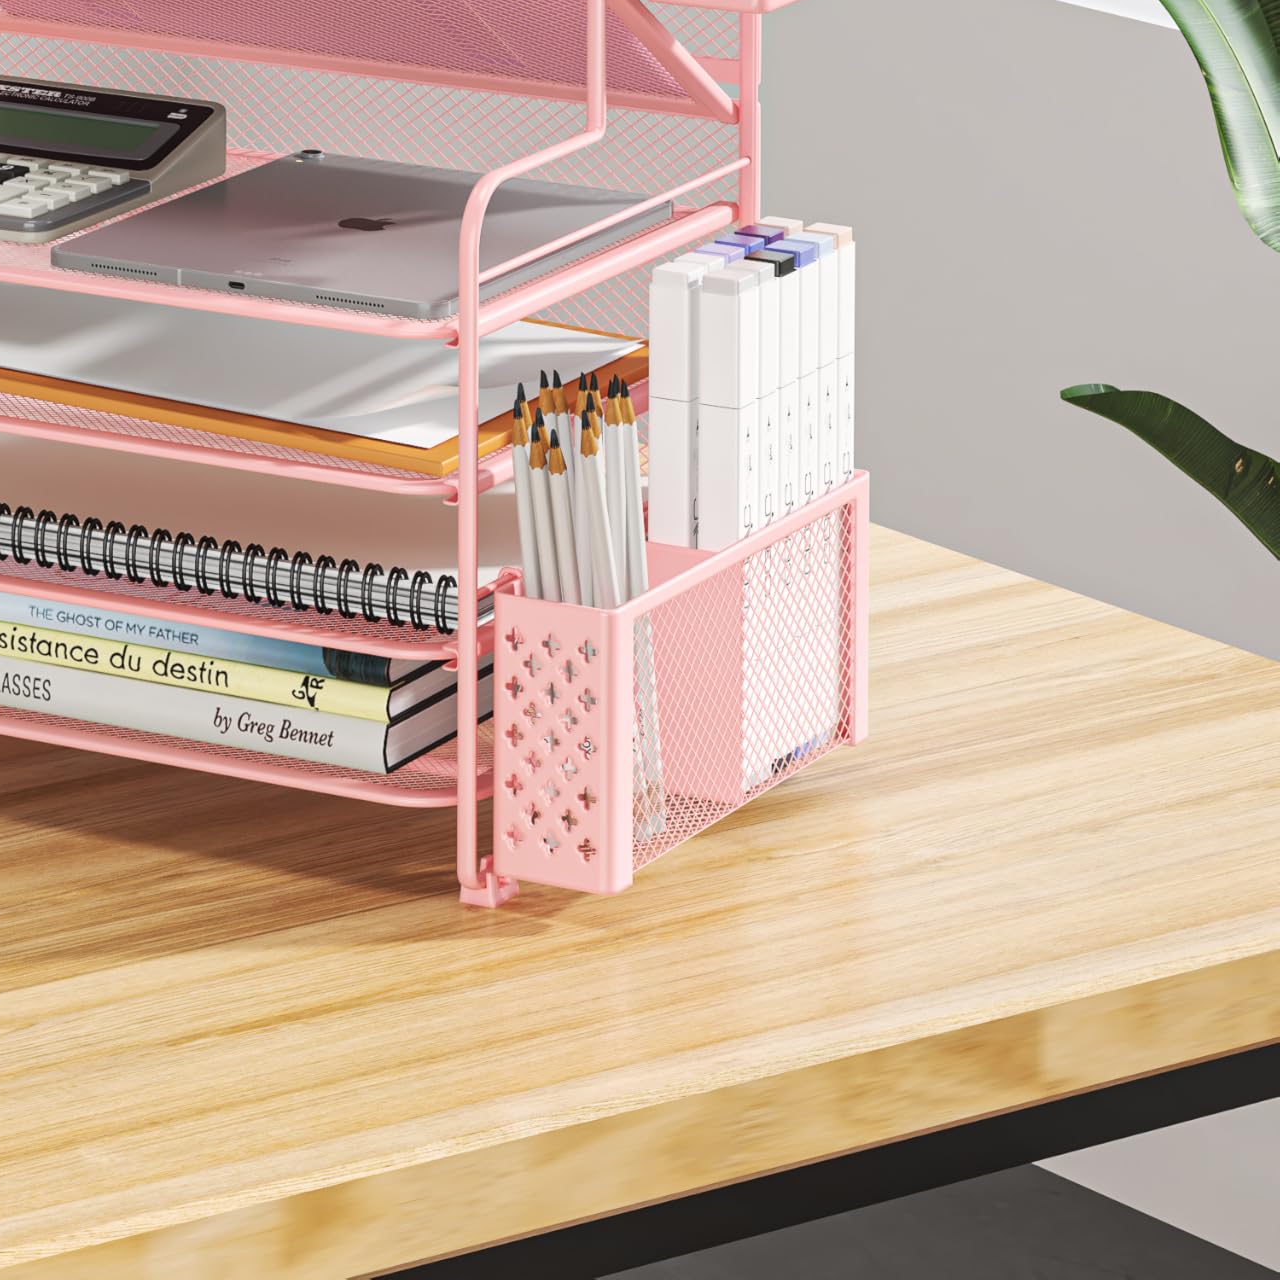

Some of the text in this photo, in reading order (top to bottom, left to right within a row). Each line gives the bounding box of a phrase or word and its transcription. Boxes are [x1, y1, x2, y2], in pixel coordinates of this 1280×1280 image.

[28, 605, 53, 621] THE
[56, 610, 102, 630] GHOST
[104, 619, 125, 632] OF
[125, 622, 147, 636] MY
[149, 626, 199, 646] FATHER
[109, 643, 141, 672] du
[152, 651, 230, 689] destin
[213, 706, 232, 734] by
[237, 711, 274, 743] Greg
[279, 719, 335, 748] Bennet
